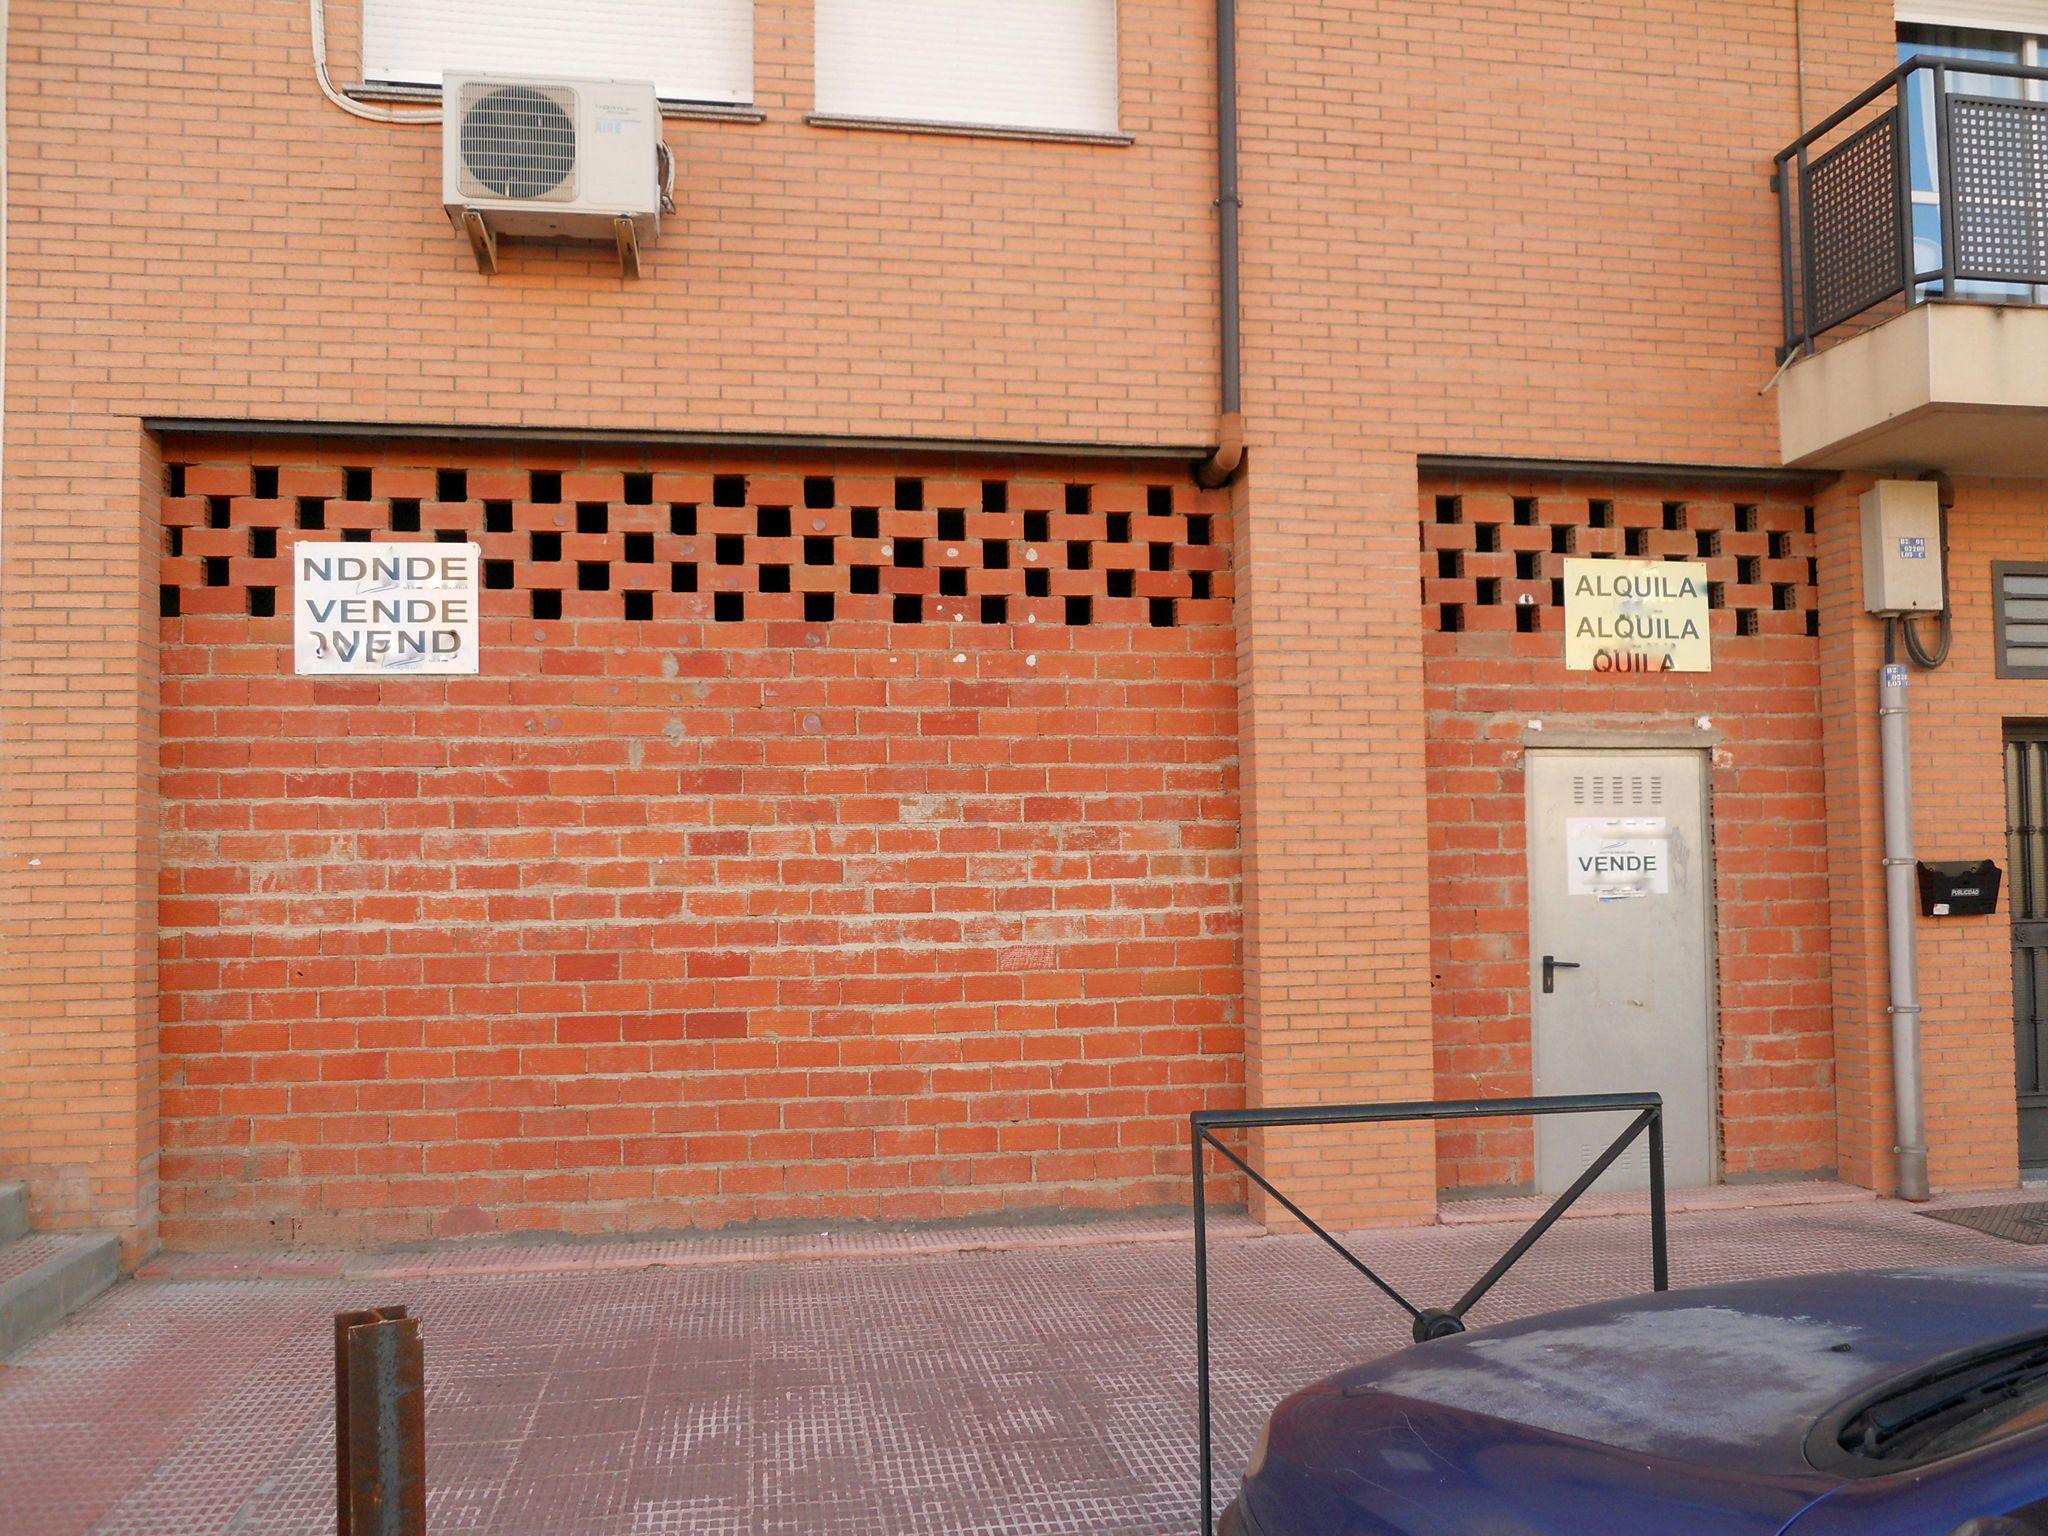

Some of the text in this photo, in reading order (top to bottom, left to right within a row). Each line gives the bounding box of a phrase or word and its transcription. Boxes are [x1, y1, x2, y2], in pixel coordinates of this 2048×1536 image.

[303, 557, 468, 581] NDNDE
[1575, 574, 1697, 598] ALQUILA
[306, 600, 468, 623] VENDE
[1576, 615, 1699, 640] ALQUILA
[1593, 650, 1675, 672] QUILA
[1578, 855, 1657, 871] VENDE
